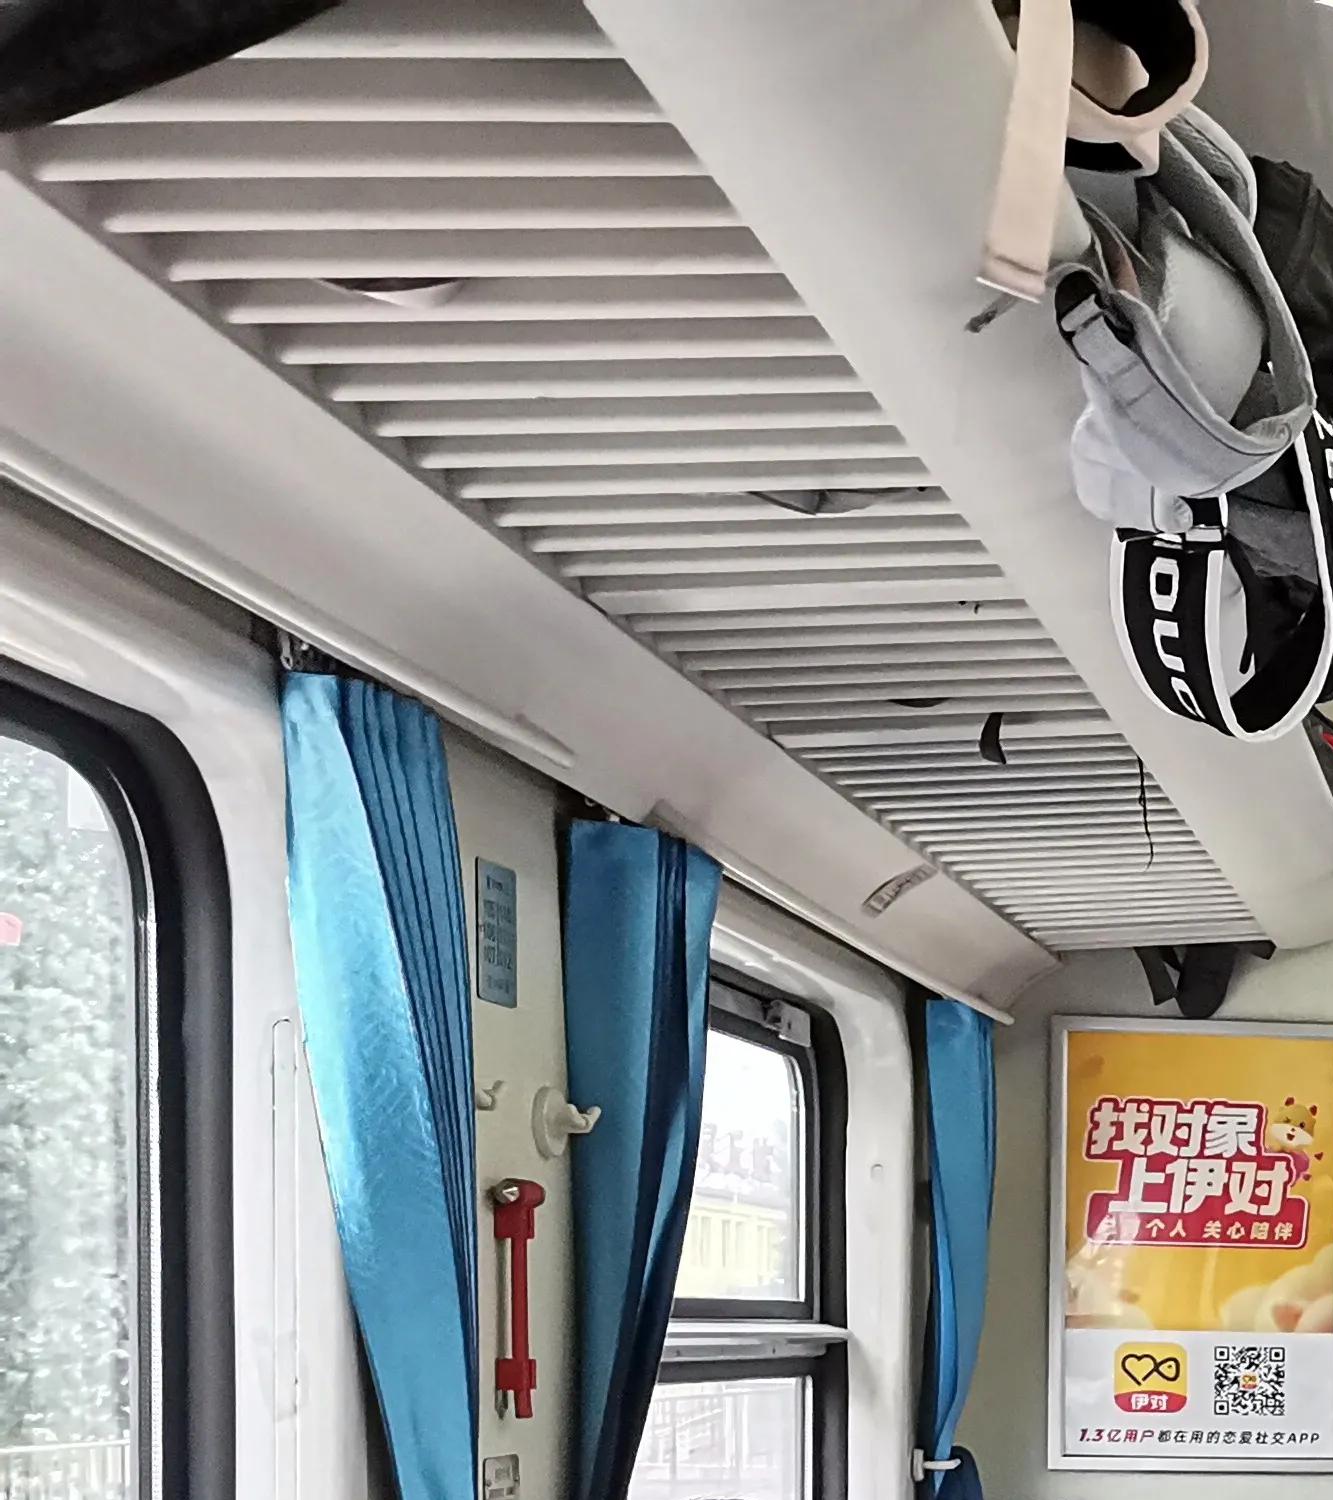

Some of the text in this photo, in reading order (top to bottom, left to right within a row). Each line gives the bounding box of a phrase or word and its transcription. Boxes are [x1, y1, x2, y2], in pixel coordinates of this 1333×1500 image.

[1090, 1101, 1258, 1158] 找对象
[1108, 1156, 1291, 1216] 上伊对
[1203, 1220, 1294, 1240] 关心陪伴
[1131, 1392, 1169, 1411] 伊对
